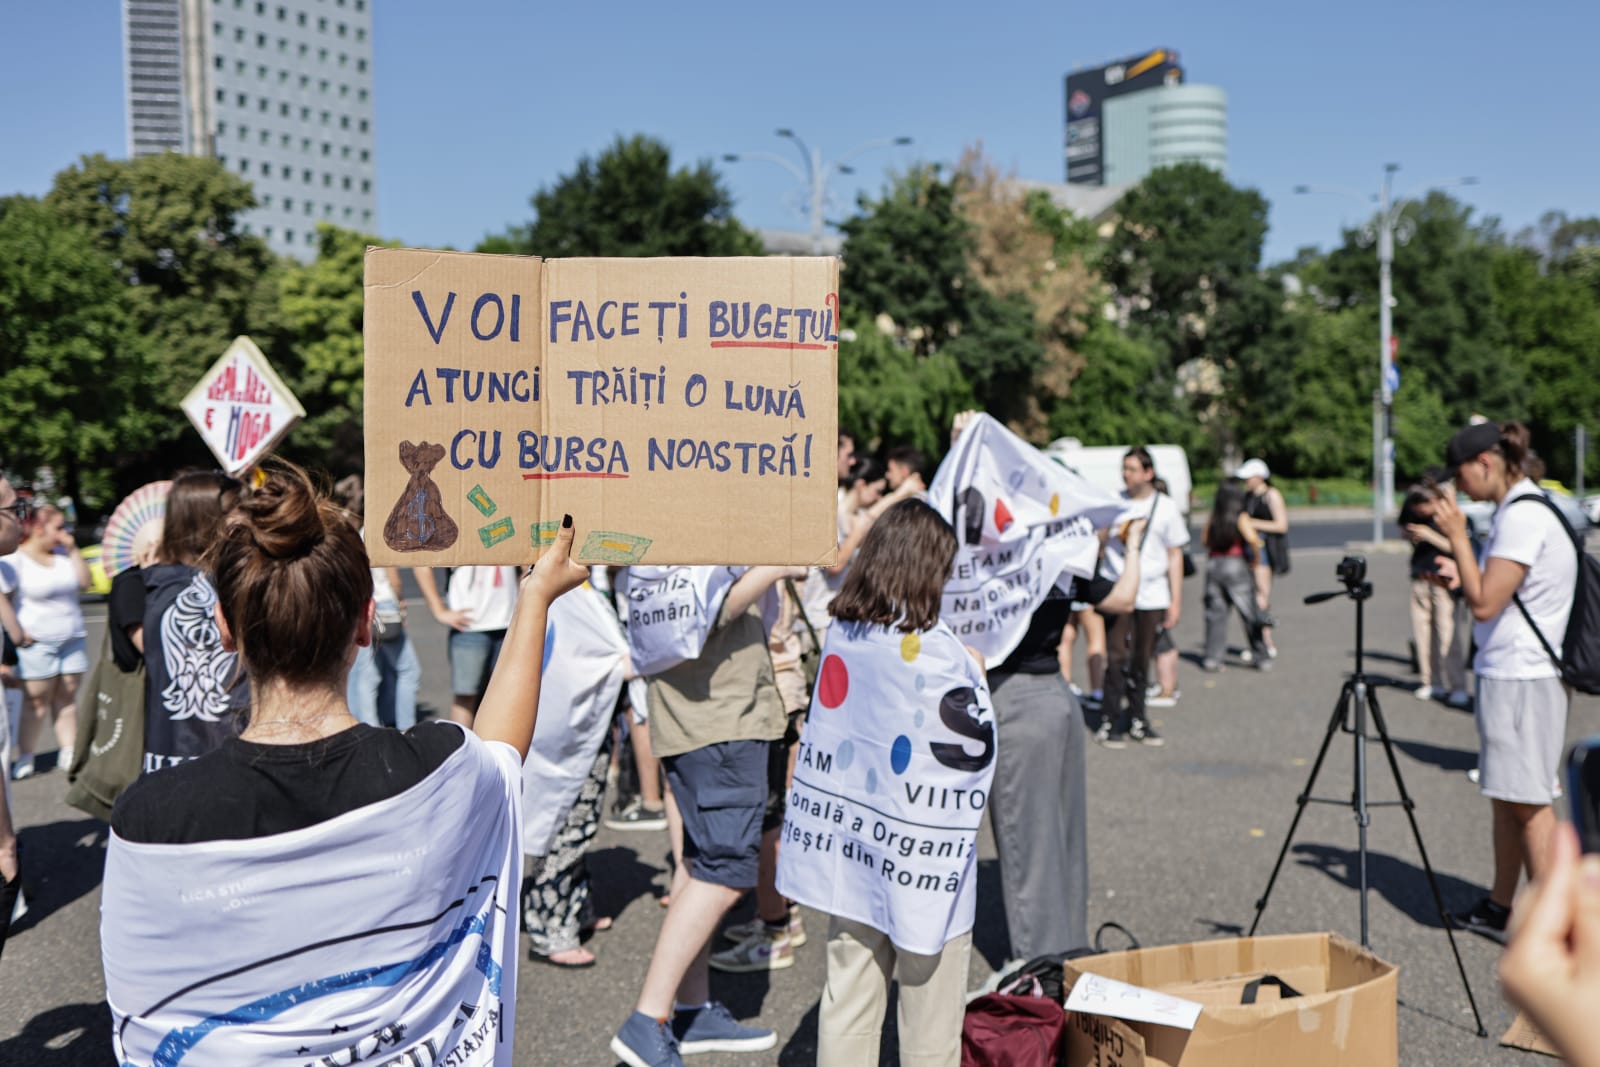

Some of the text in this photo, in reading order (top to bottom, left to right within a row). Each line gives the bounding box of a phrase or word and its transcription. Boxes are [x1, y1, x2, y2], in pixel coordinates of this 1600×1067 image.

[411, 290, 521, 345] VOI
[549, 291, 688, 344] FACEȚI
[404, 366, 806, 418] ATUNCI TRĂIȚI O LUNĂ
[450, 429, 813, 478] CU BURSA NOASTRĂ!
[905, 782, 986, 810] VIITO
[851, 816, 863, 842] a
[842, 841, 874, 868] din
[881, 857, 959, 893] Româ
